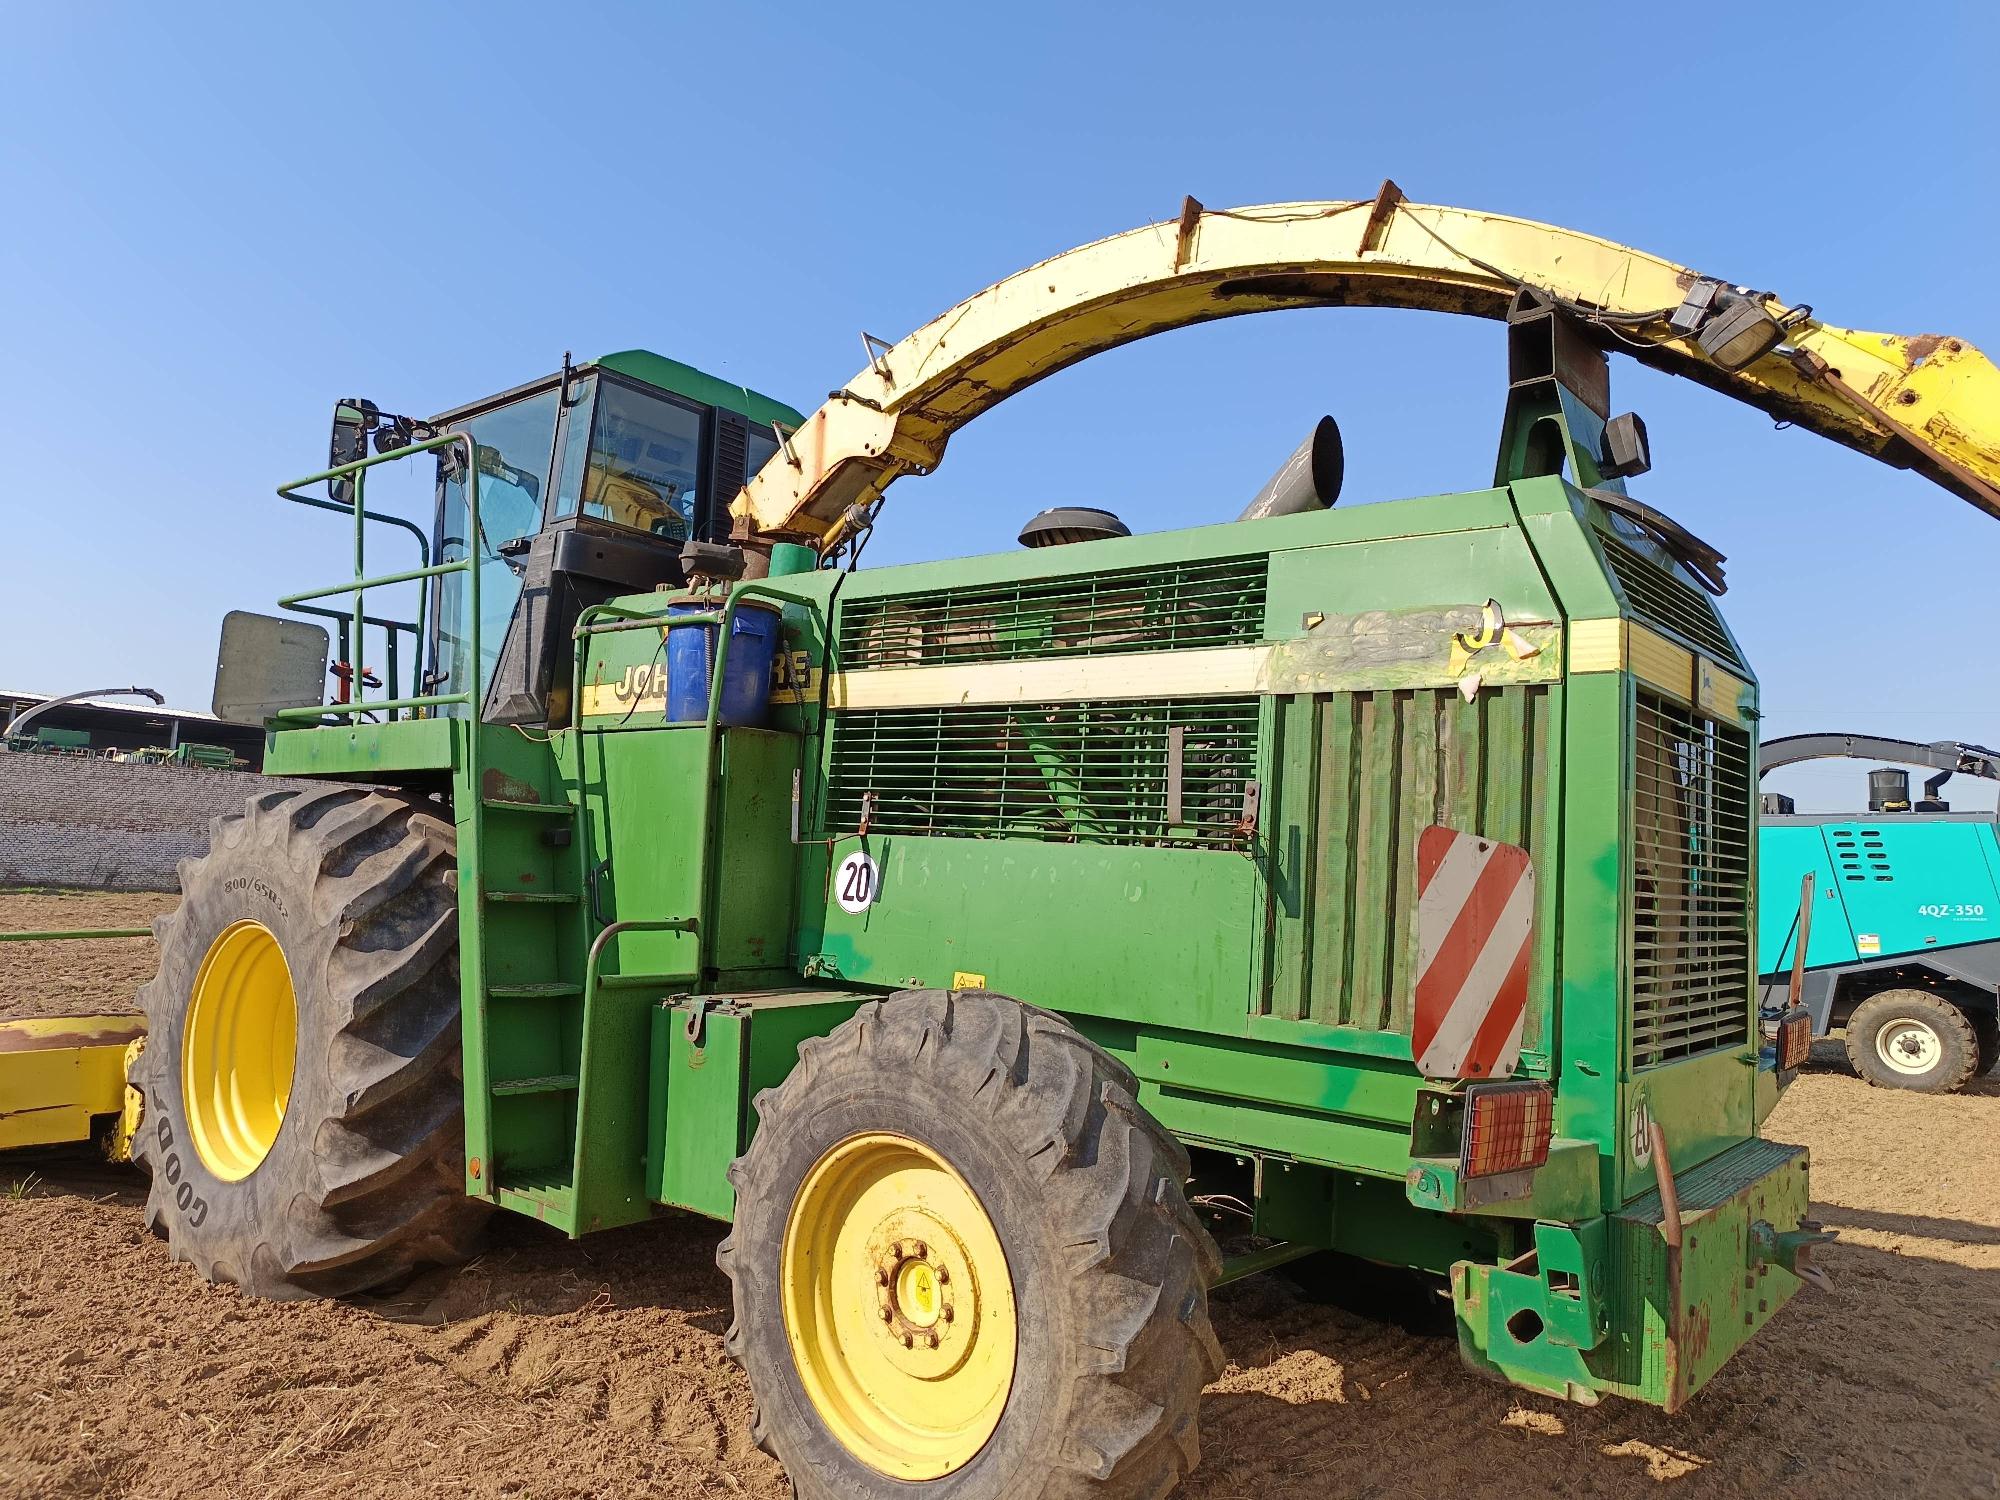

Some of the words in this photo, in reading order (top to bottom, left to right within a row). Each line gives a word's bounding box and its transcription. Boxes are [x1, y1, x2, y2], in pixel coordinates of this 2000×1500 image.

[615, 663, 668, 701] JOH
[842, 861, 871, 902] 20
[1918, 904, 1984, 918] 4QZ-350
